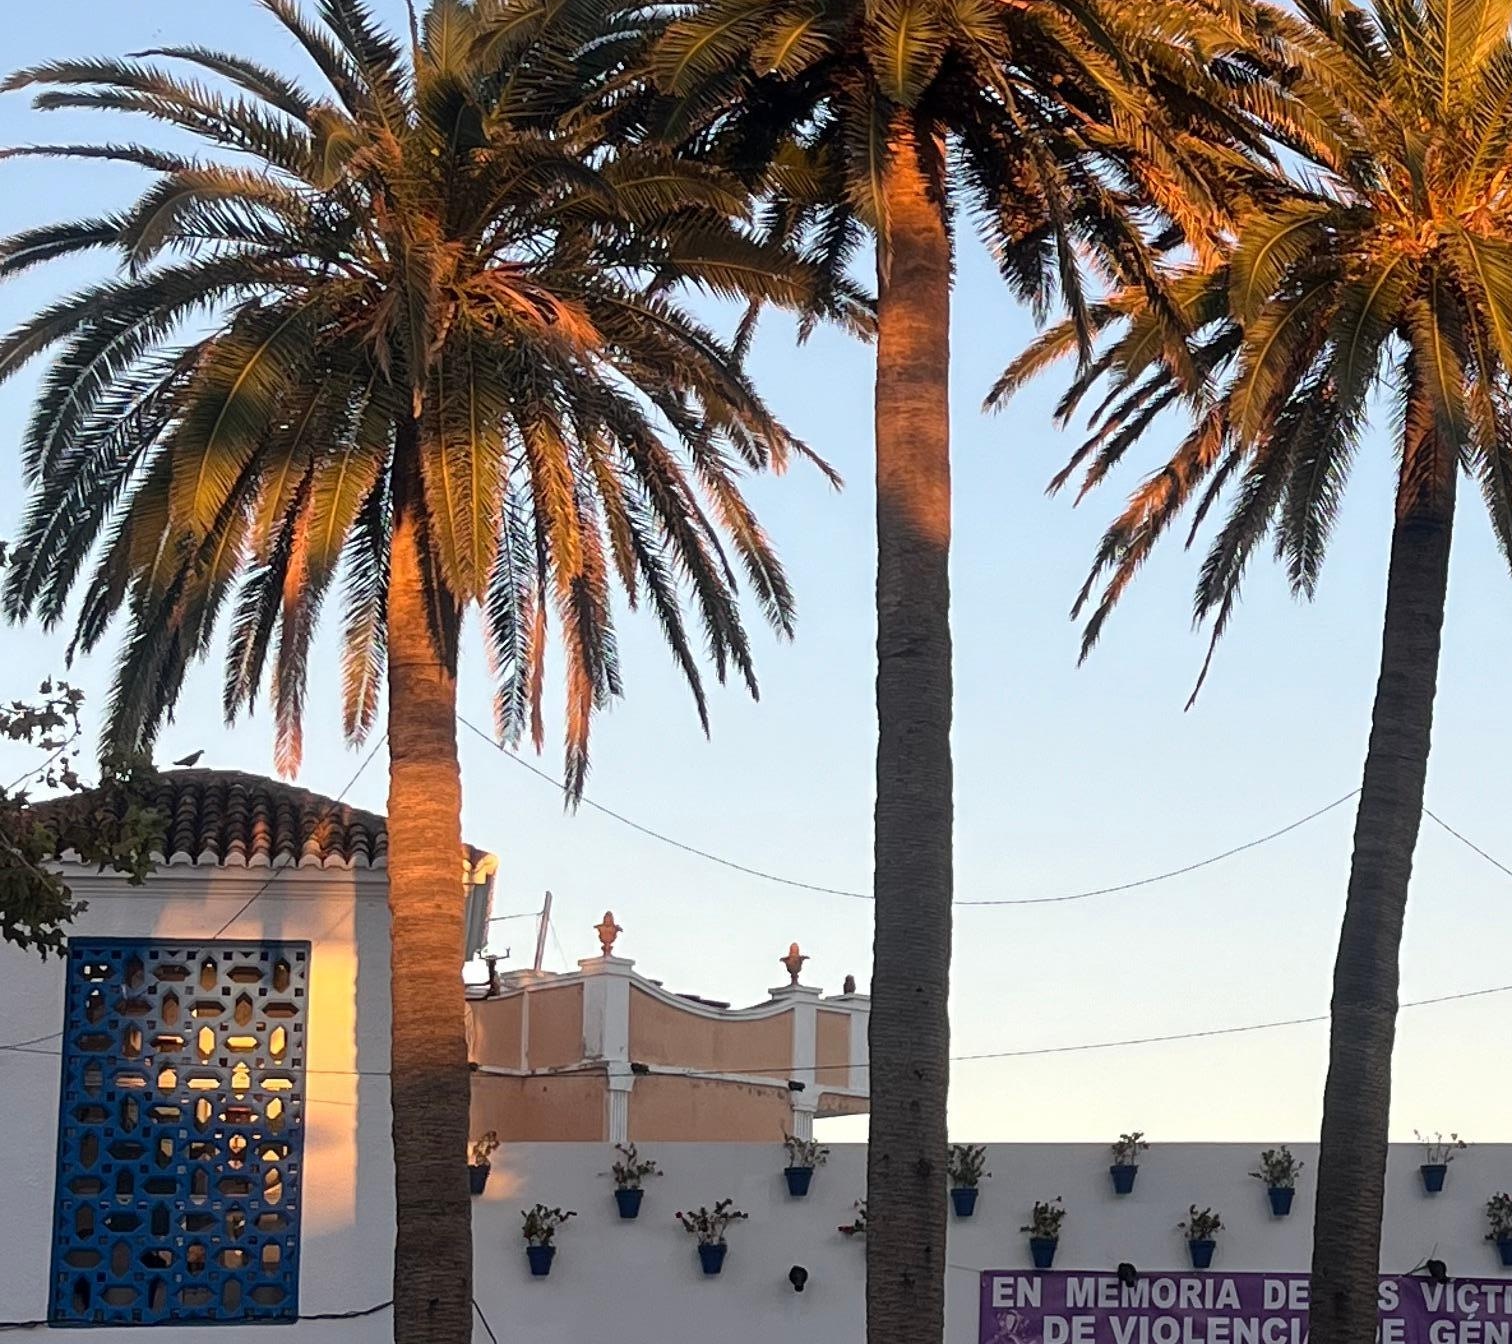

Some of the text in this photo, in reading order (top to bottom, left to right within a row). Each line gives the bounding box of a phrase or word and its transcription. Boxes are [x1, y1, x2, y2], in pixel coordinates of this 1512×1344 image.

[992, 1276, 1041, 1308] EN
[1066, 1276, 1241, 1310] MEMORIA
[1264, 1279, 1309, 1310] DE
